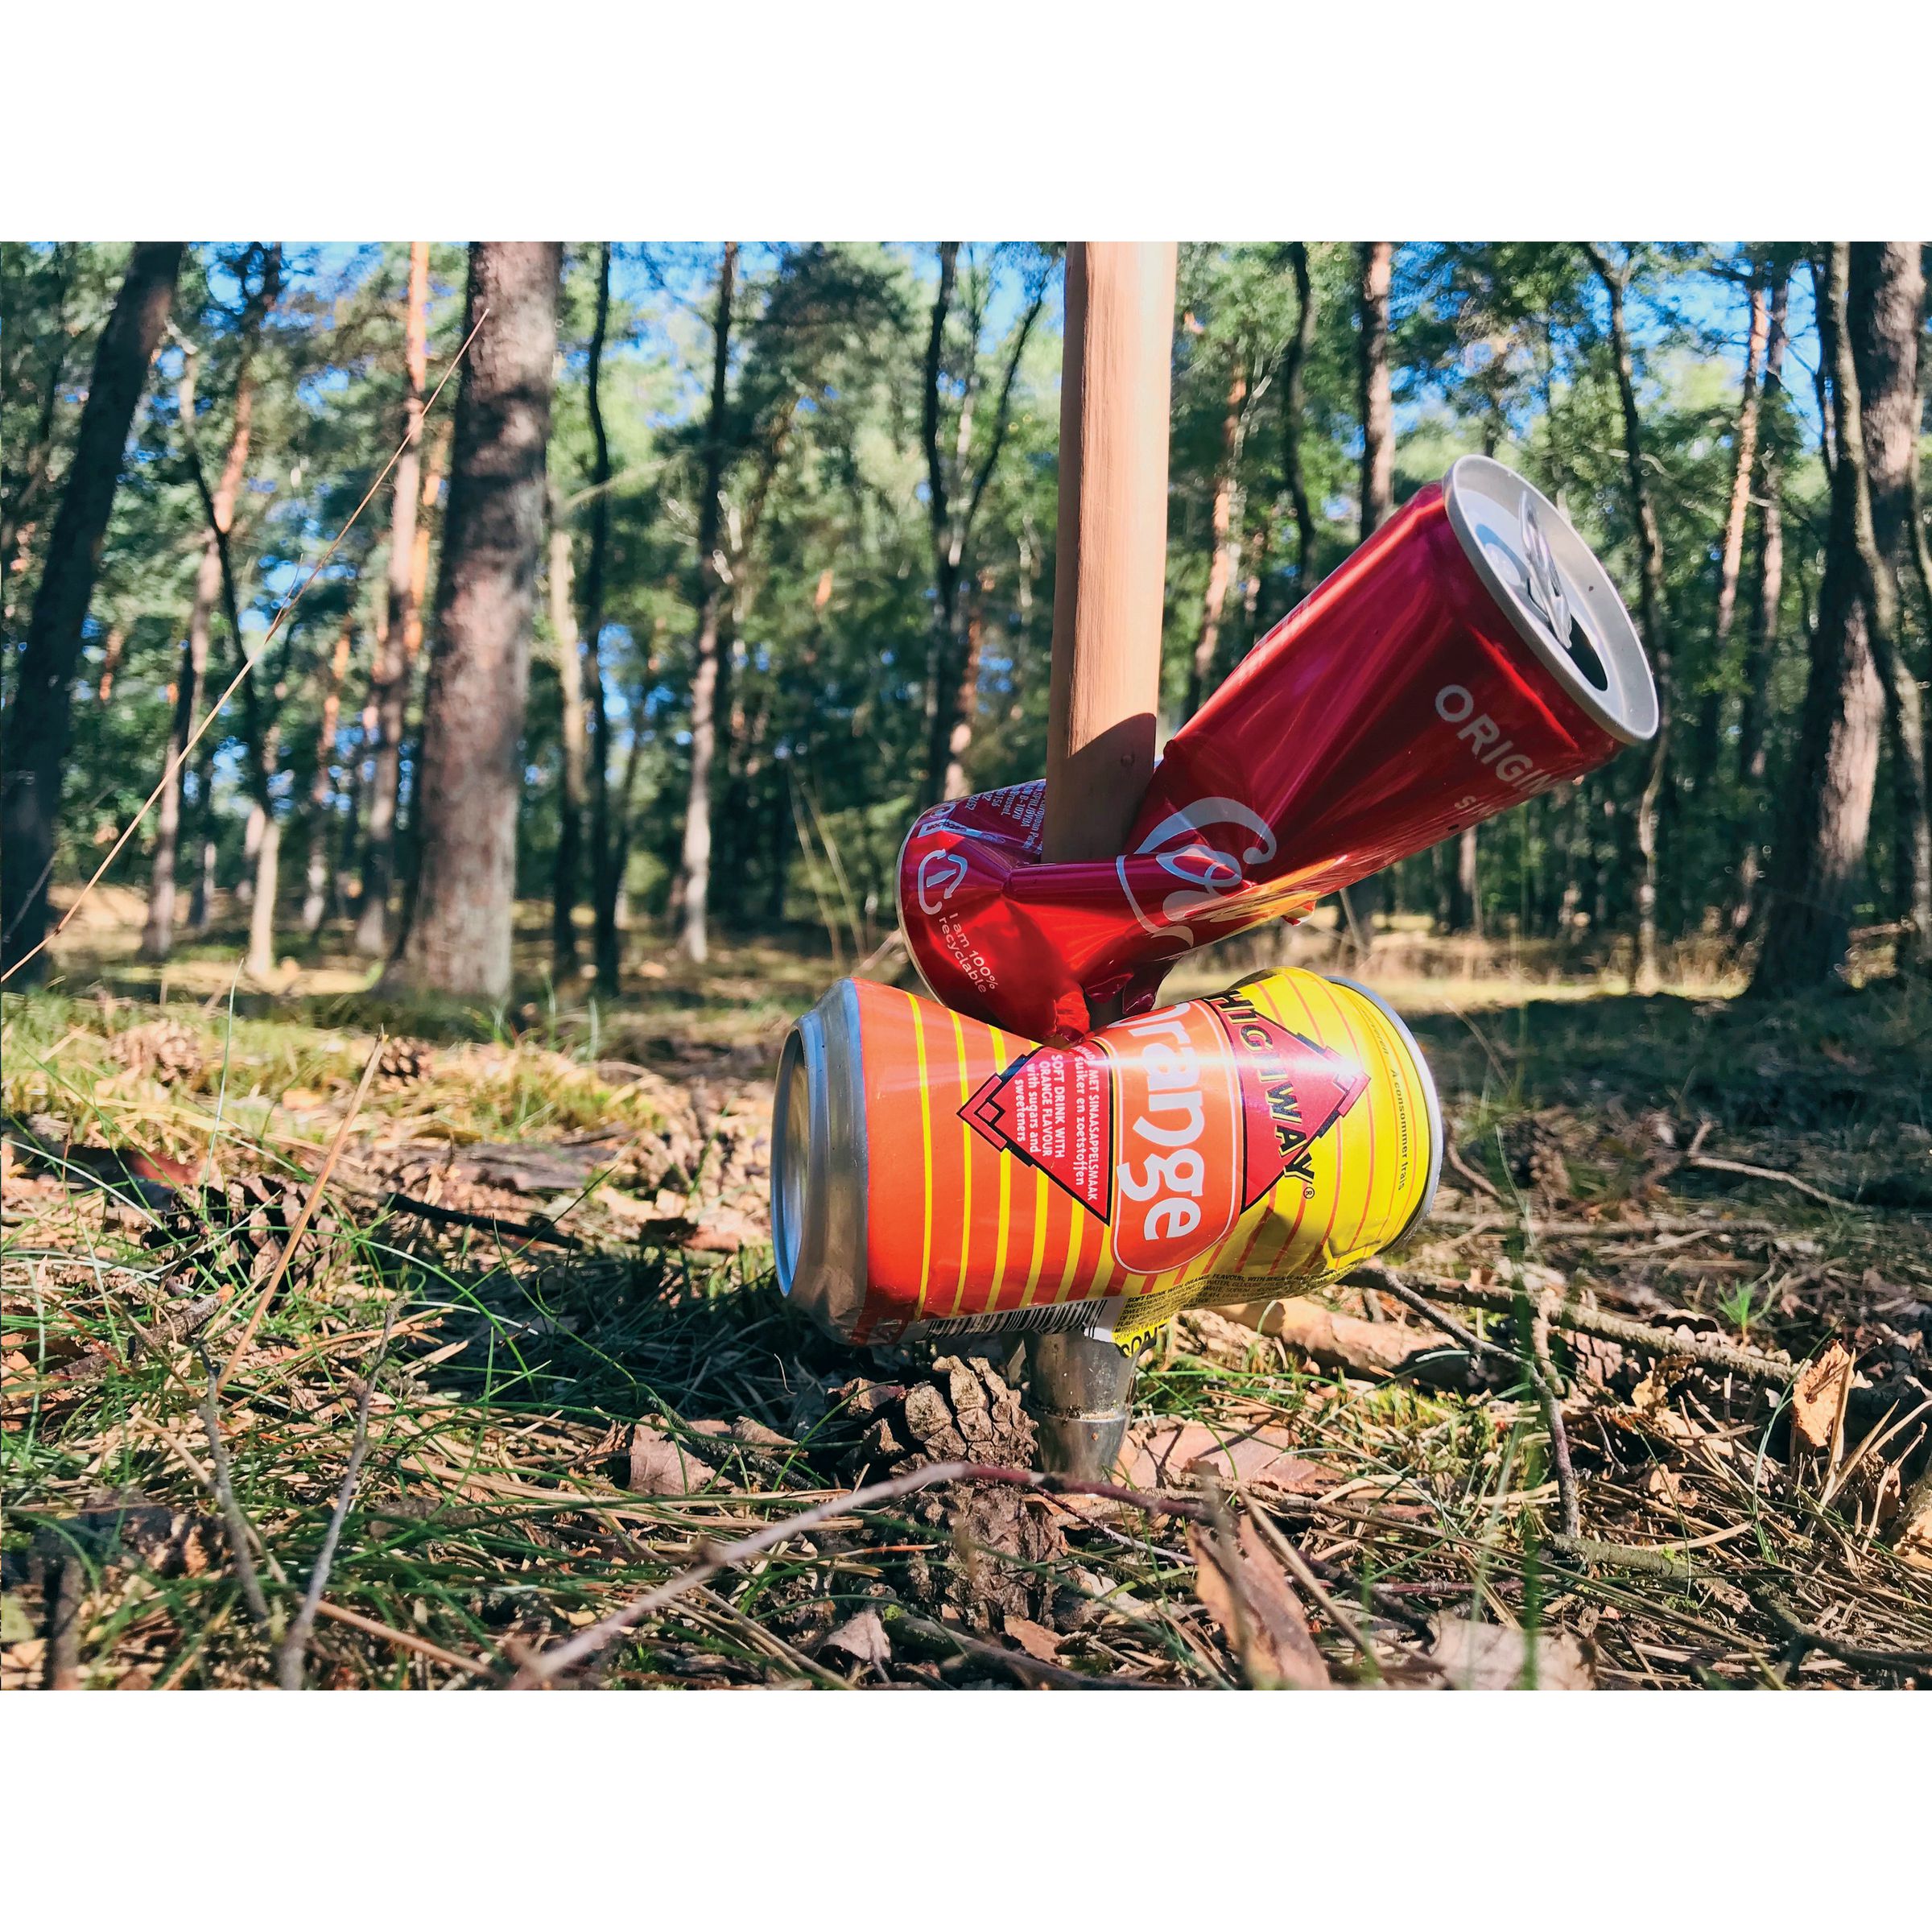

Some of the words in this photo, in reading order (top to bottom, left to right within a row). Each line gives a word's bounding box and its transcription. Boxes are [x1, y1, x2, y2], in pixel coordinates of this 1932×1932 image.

[939, 917, 987, 993] recyclable
[953, 924, 970, 948] am
[969, 950, 998, 990] 100%
[1027, 1063, 1040, 1088] with
[1039, 1061, 1053, 1108] ORANGE
[1051, 1054, 1065, 1082] SOFT
[1074, 1055, 1088, 1094] suiker
[1088, 1070, 1100, 1092] MET
[1205, 990, 1315, 1184] HIGHWAY
[1014, 1079, 1026, 1142] sweeteners
[1025, 1092, 1038, 1129] sugars
[1054, 1087, 1065, 1125] DRINK
[1076, 1097, 1085, 1113] en
[1394, 1082, 1408, 1159] consommer
[1030, 1132, 1041, 1154] and
[1042, 1109, 1053, 1157] FLAVOUR
[1055, 1128, 1065, 1158] WITH
[1073, 1115, 1088, 1186] zoetstoffen
[1088, 1092, 1100, 1200] SINAASAPPELSMAAK
[1127, 1295, 1146, 1303] SOFT
